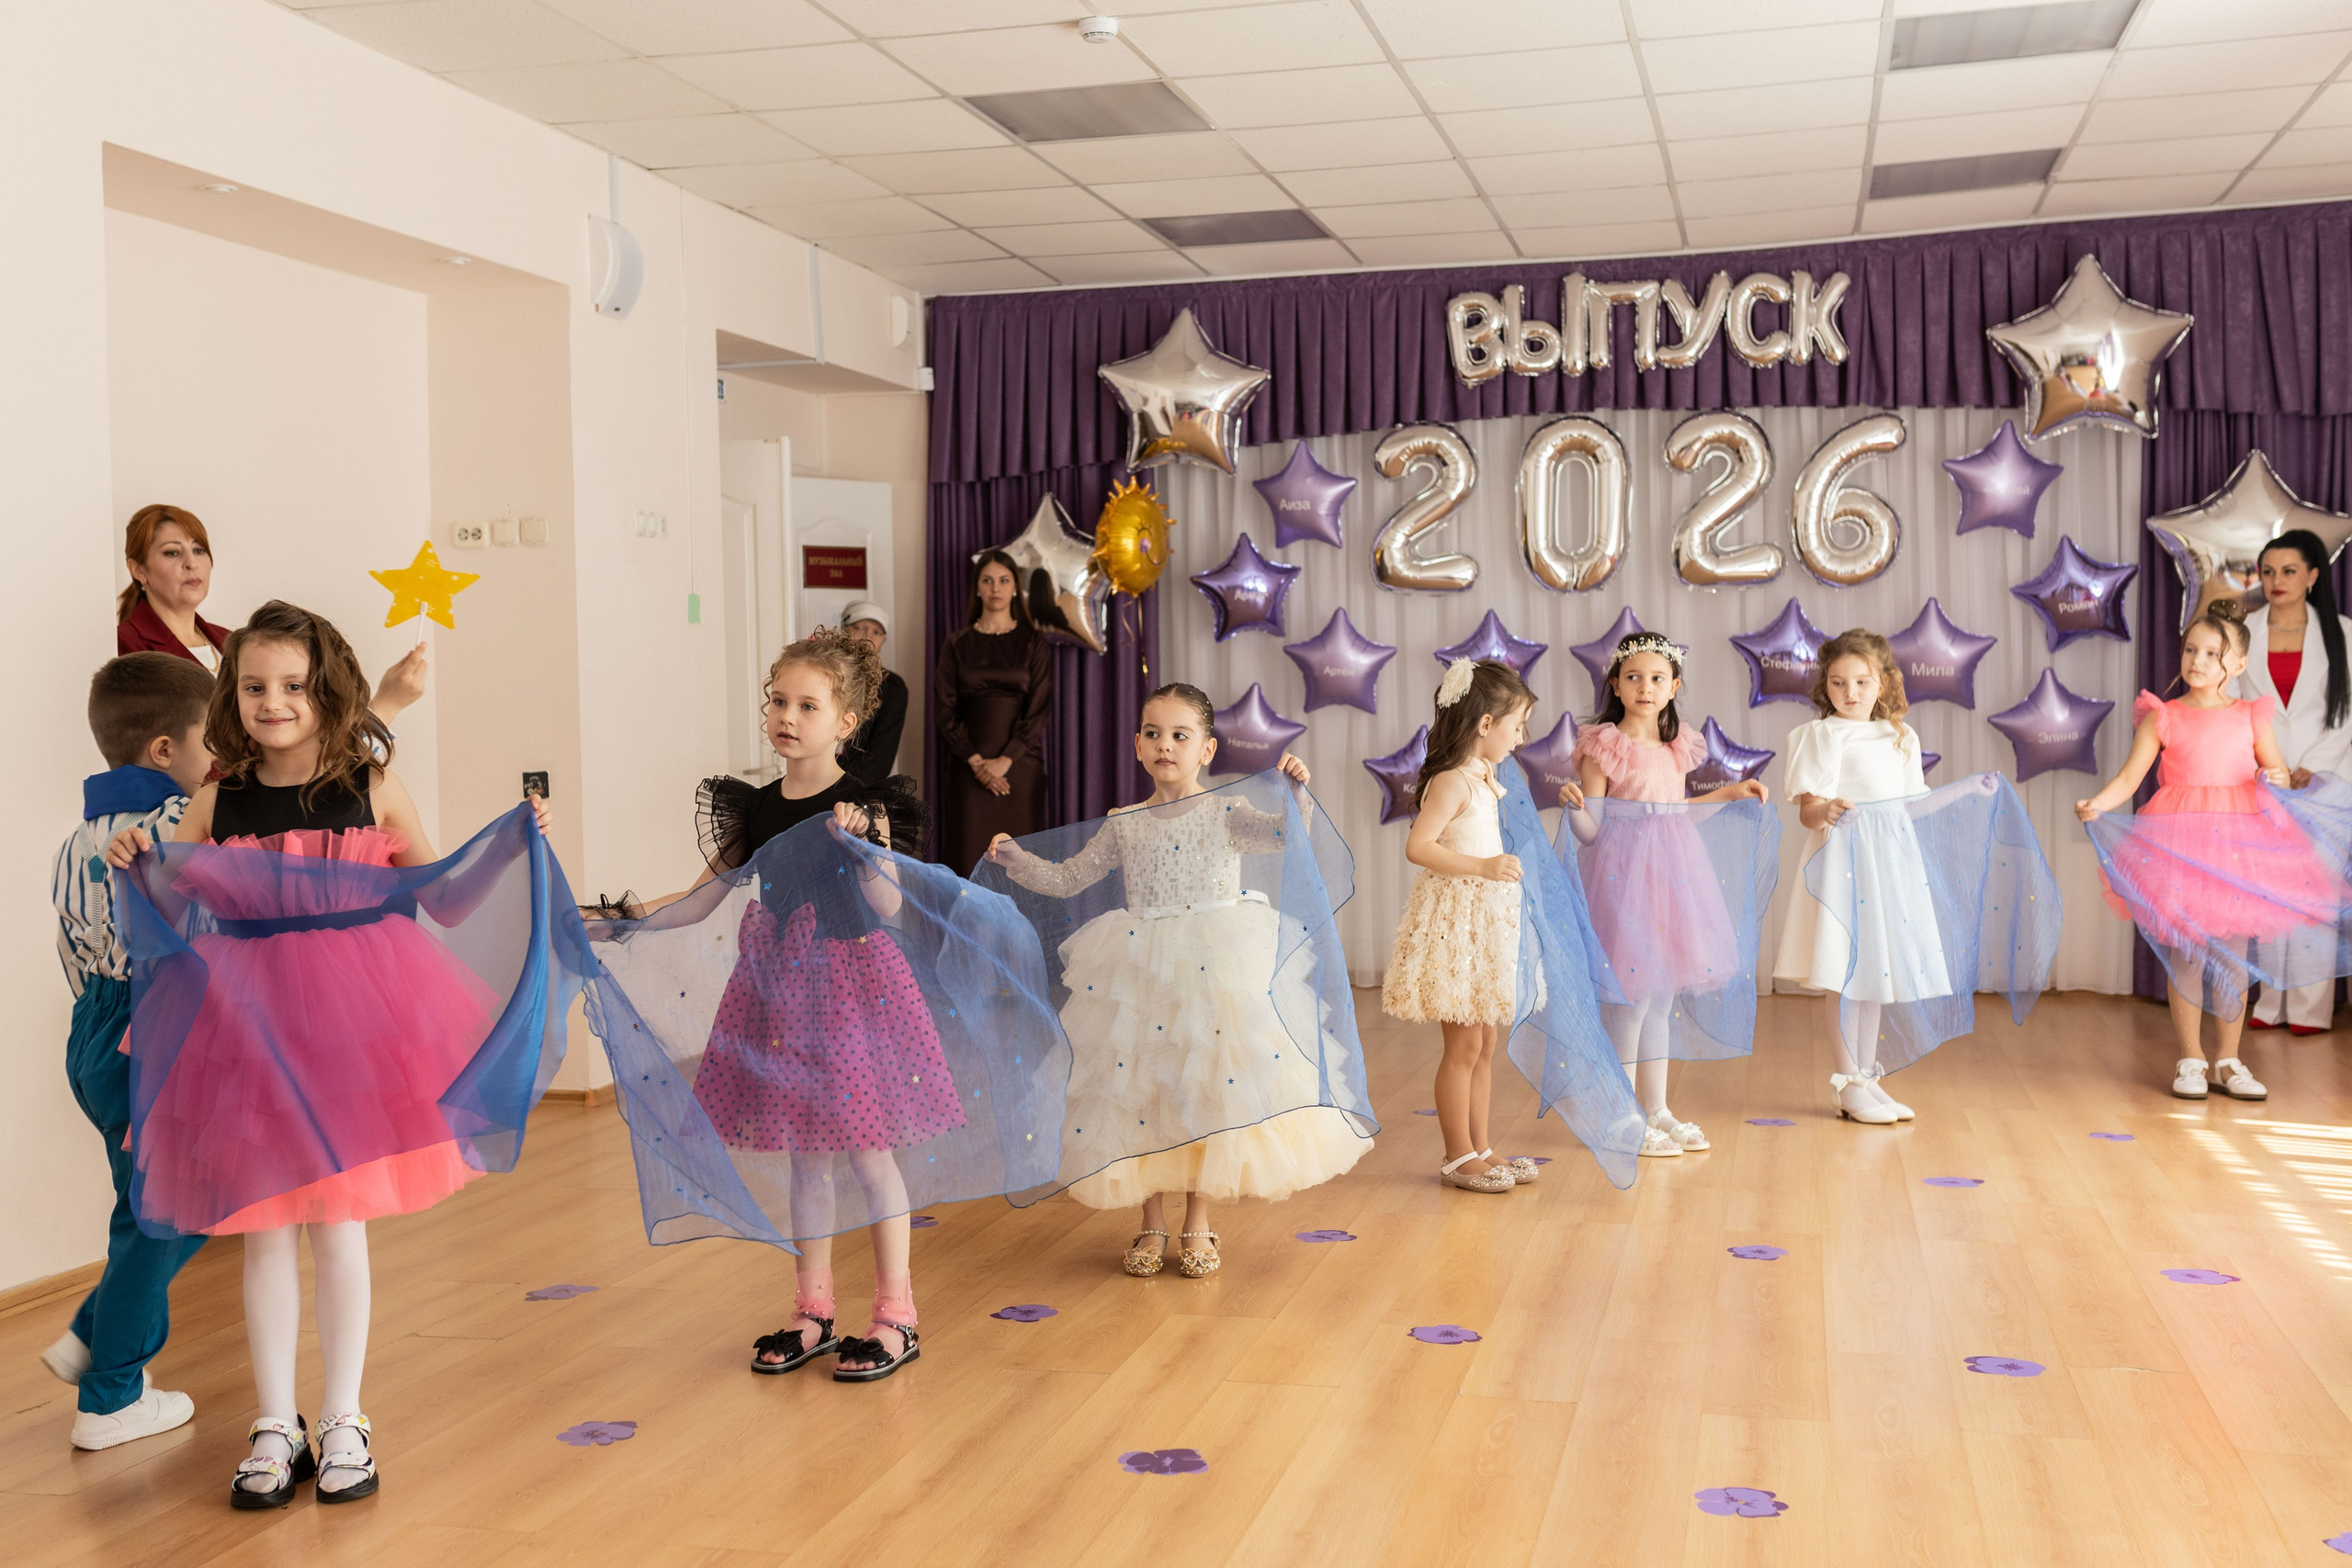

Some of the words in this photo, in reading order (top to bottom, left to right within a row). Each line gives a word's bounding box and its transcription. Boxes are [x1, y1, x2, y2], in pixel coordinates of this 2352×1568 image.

[1447, 270, 1851, 388] ВЫПУСК
[1372, 410, 1906, 593] 2026
[1912, 662, 1954, 677] Мила
[2039, 730, 2078, 744] Элина
